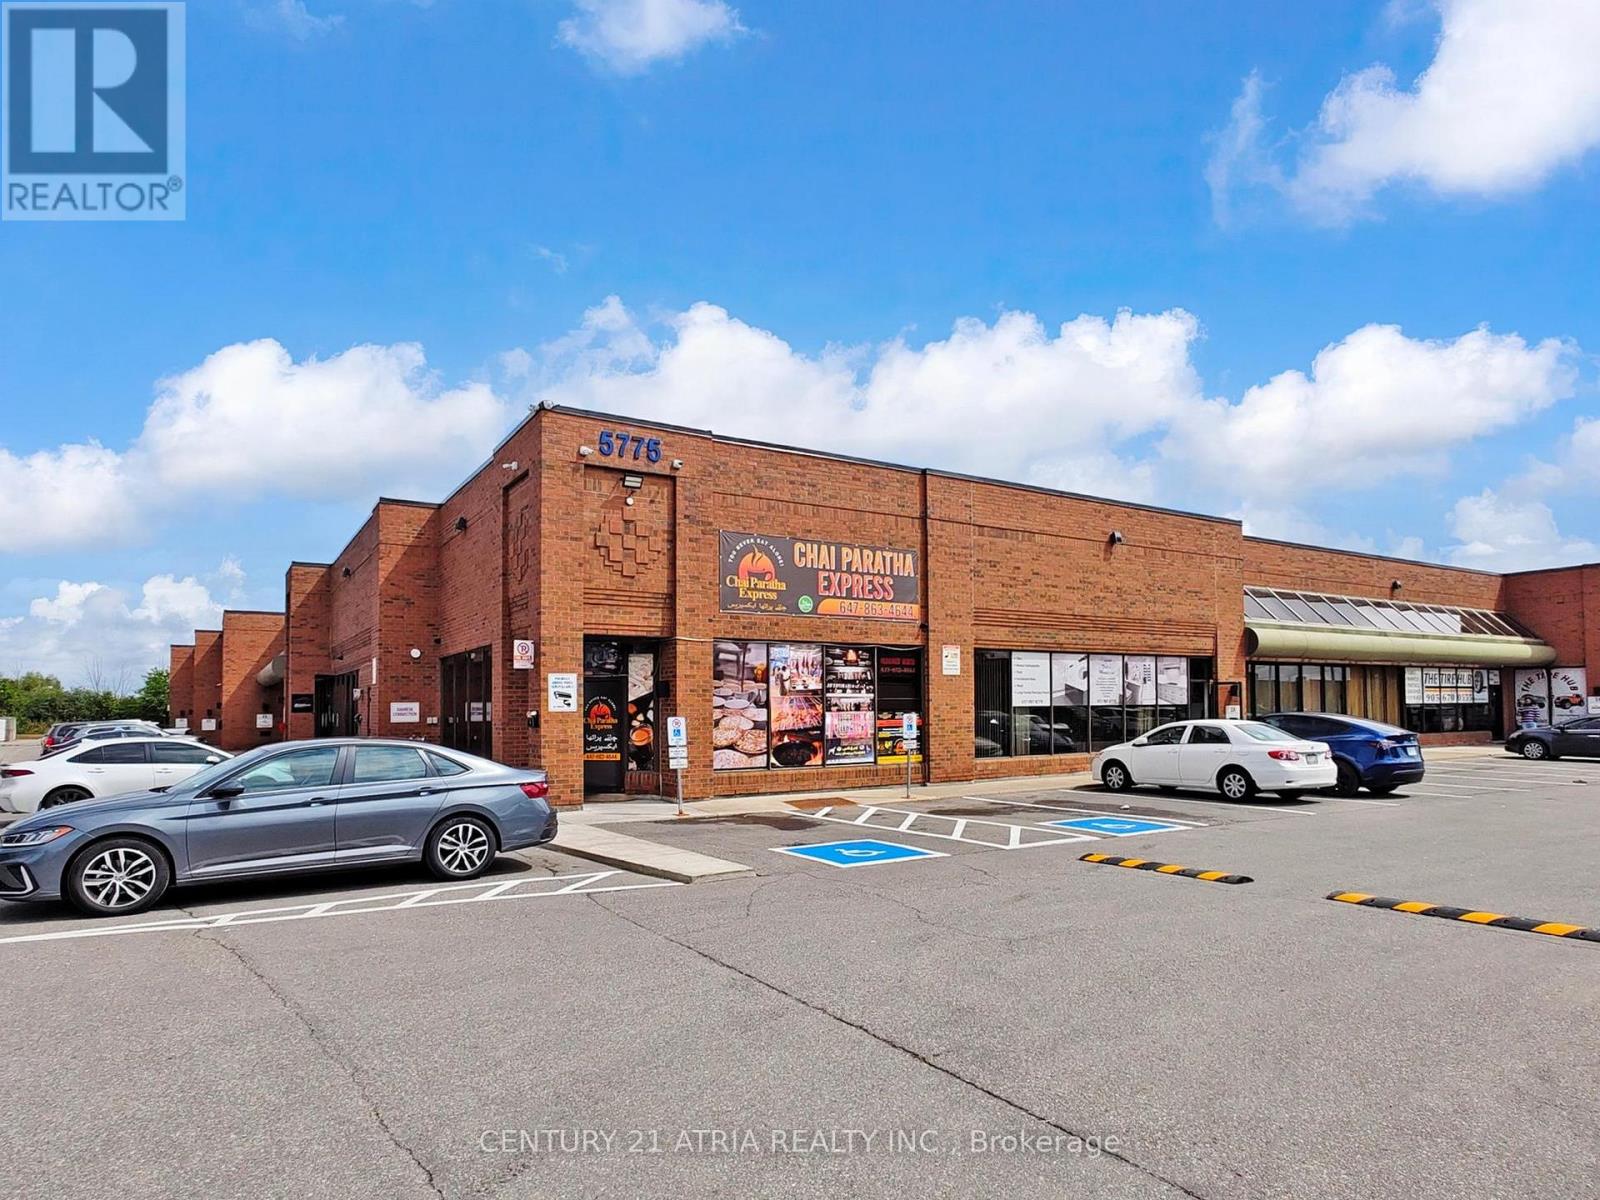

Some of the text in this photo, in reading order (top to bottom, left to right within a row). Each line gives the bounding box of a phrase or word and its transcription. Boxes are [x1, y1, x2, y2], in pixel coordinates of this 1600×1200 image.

[599, 430, 662, 463] 5775
[793, 542, 915, 577] CHAI PARATHA
[726, 574, 787, 590] Chai Paratha
[818, 571, 894, 600] EXPRESS
[739, 587, 778, 601] Express
[839, 600, 913, 617] 647-863-4644
[1424, 673, 1472, 685] THE TIRE HUB
[1521, 672, 1579, 692] THE TIE HUB
